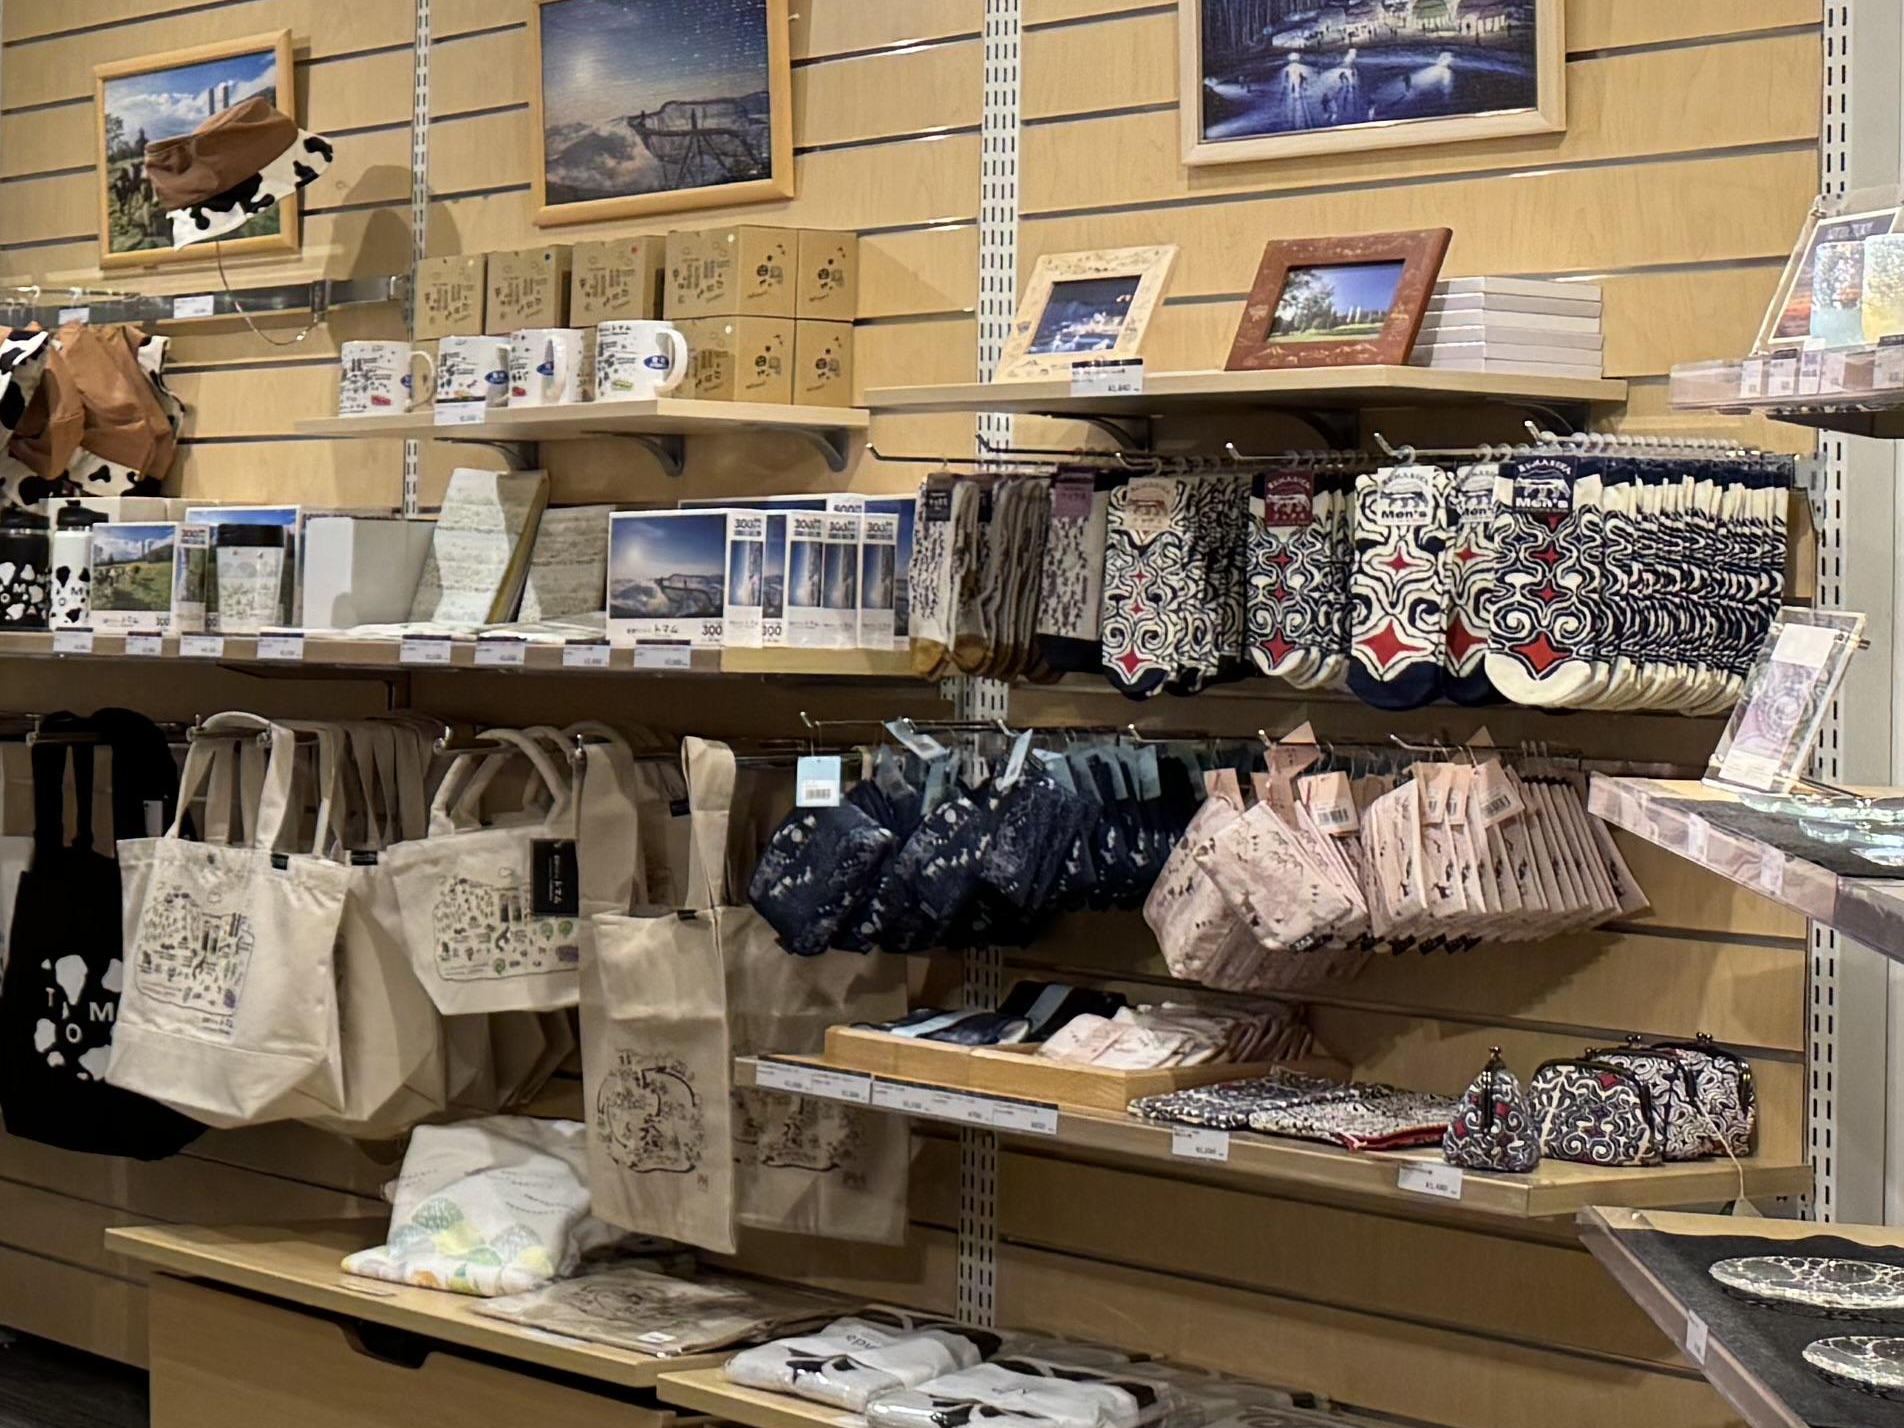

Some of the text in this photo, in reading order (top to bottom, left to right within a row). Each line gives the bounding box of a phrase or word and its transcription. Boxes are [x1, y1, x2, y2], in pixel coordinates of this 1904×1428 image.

[1515, 497, 1568, 508] Men's
[1381, 510, 1427, 519] Men's
[701, 624, 723, 636] 300
